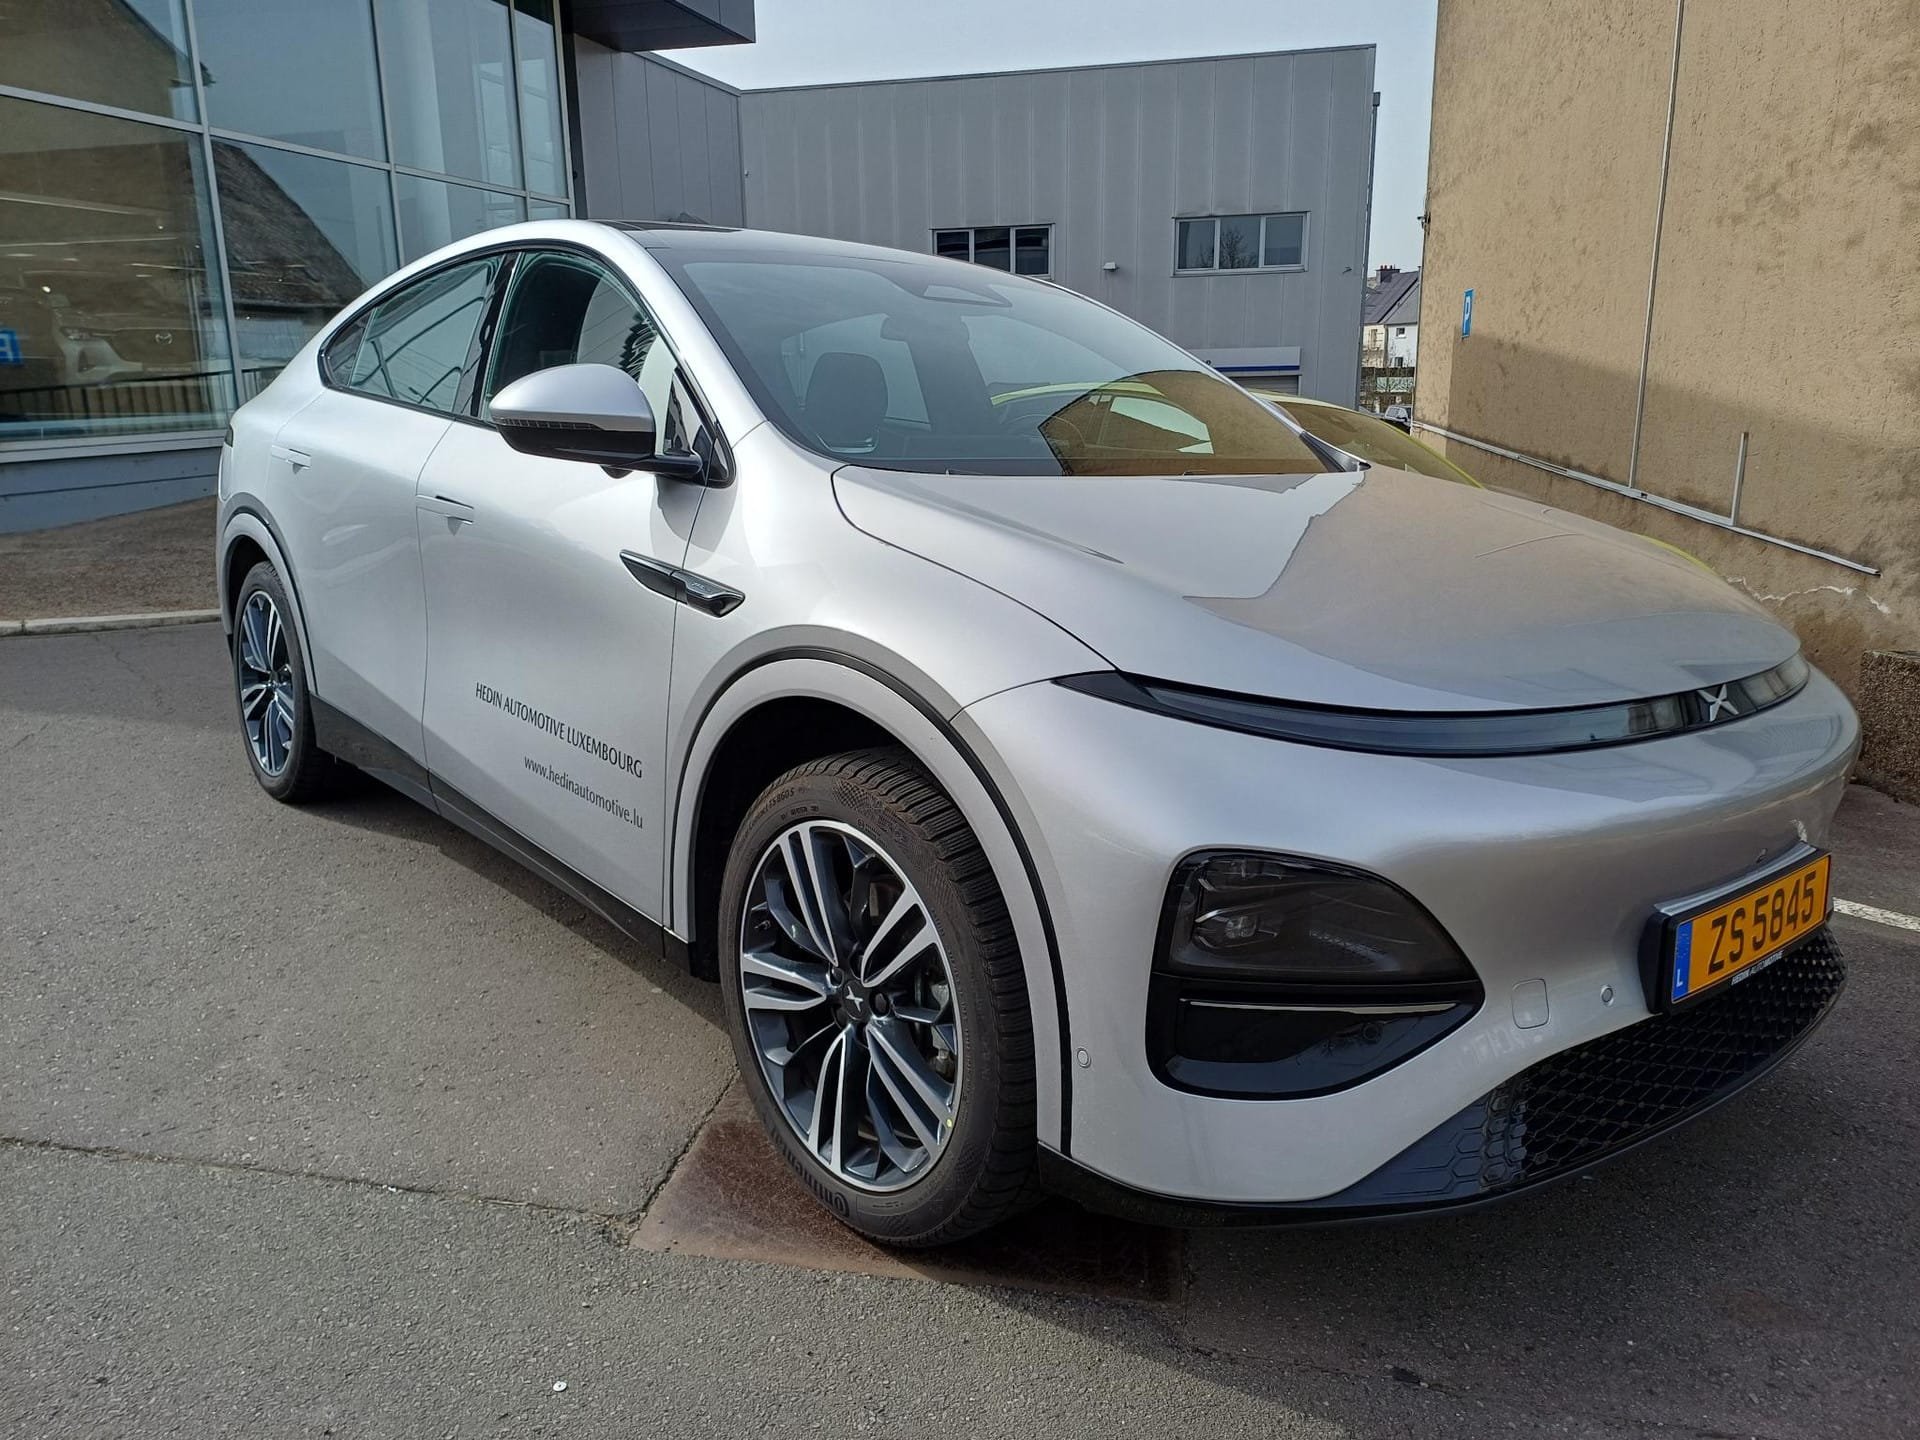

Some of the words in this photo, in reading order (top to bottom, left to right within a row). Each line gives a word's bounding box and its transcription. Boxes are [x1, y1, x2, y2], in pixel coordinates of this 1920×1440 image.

[475, 682, 502, 709] HEDIN
[503, 697, 565, 740] AUTOMOTIVE
[567, 726, 642, 779] LUXEMBOURG
[524, 755, 643, 828] www.hedinautomotive.lu
[1676, 969, 1684, 987] L
